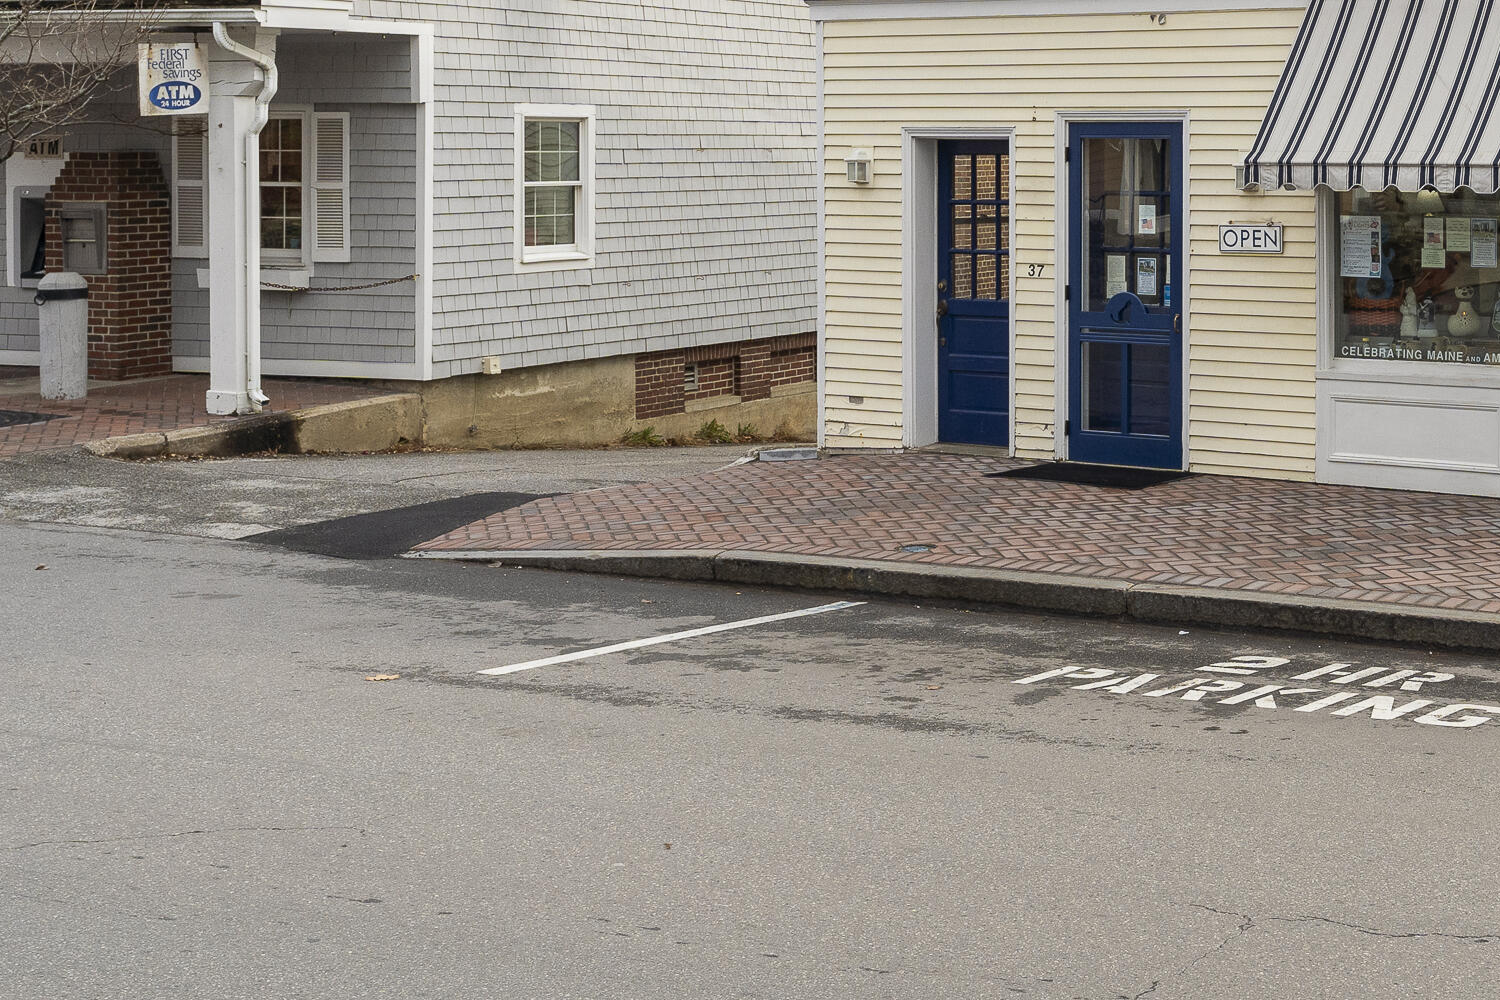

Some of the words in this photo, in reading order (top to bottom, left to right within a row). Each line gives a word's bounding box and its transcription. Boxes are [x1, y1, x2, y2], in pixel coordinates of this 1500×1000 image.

[160, 48, 190, 60] FIRST
[147, 57, 185, 69] Federal
[156, 85, 195, 100] ATM
[28, 138, 60, 155] ATM
[1222, 229, 1278, 248] OPEN
[1027, 264, 1045, 278] 37
[1341, 345, 1423, 360] CELEBRATING
[1426, 350, 1464, 362] MAINE
[1193, 655, 1291, 675] 2
[1289, 663, 1456, 692] HR
